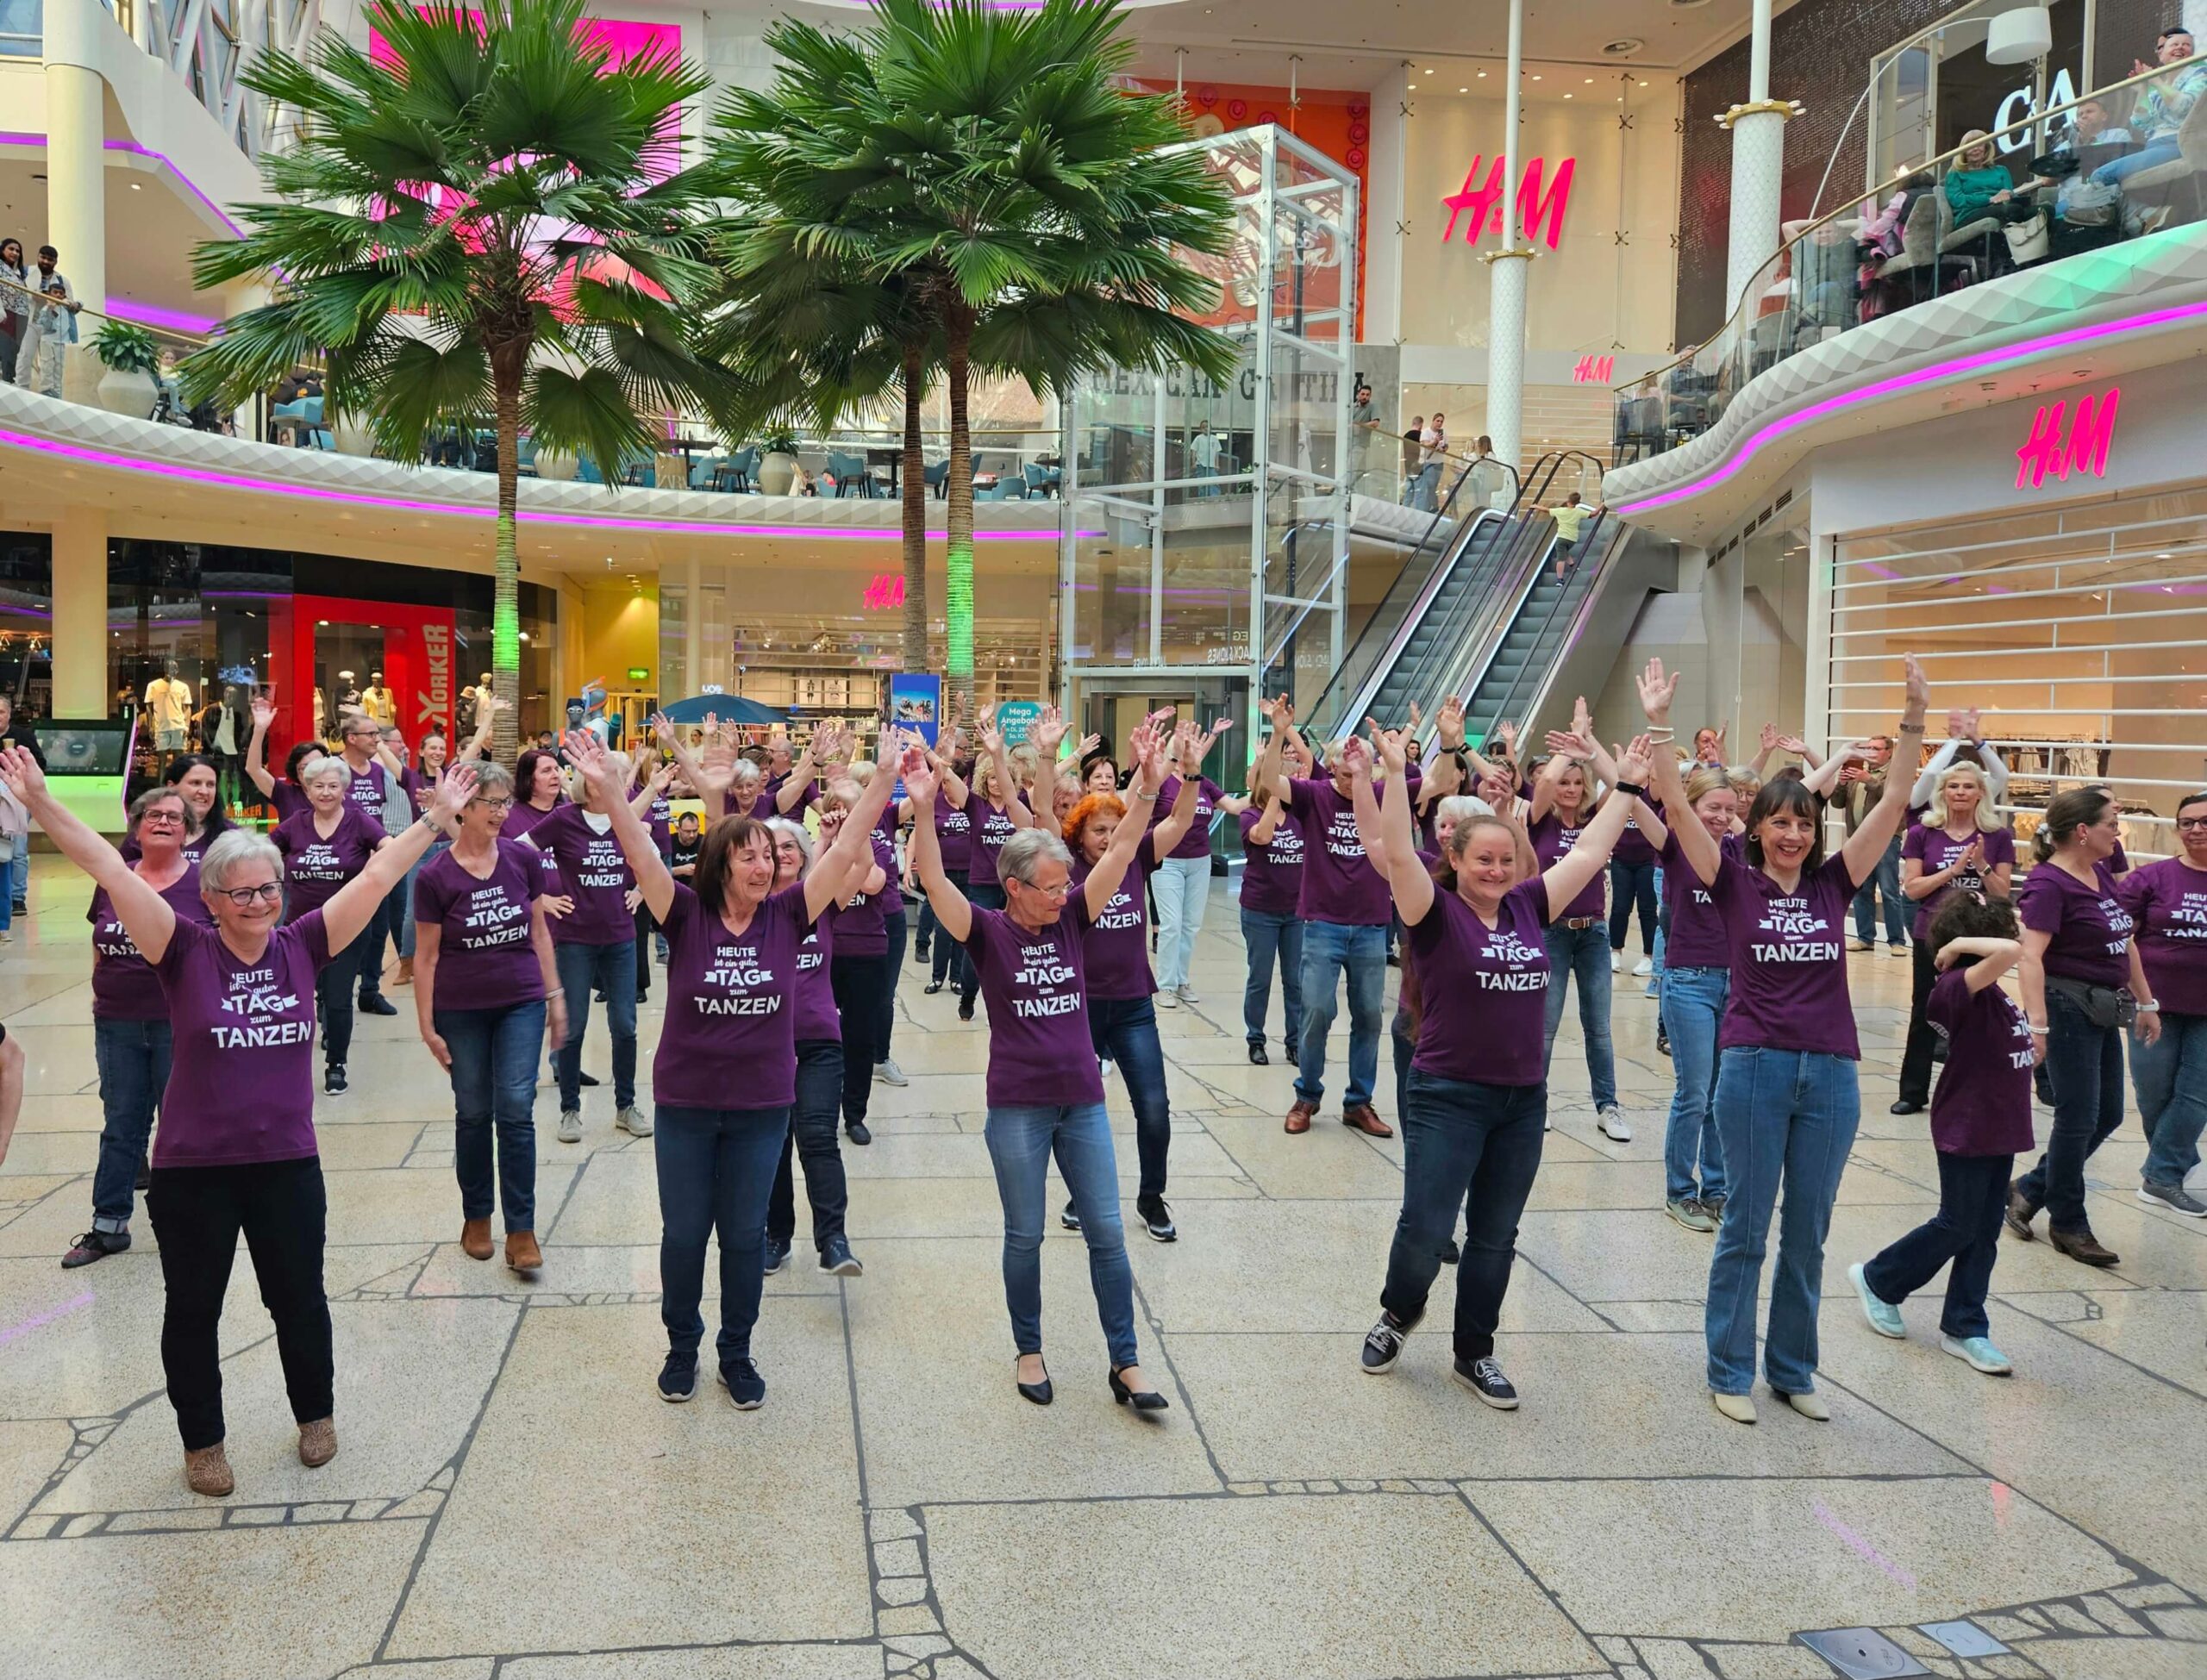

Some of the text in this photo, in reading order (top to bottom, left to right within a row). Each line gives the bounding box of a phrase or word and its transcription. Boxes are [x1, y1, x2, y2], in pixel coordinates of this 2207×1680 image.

[1572, 353, 1615, 384] H&M
[2015, 387, 2121, 490] H&M
[1009, 708, 1032, 717] Mega
[1195, 806, 1212, 815] ZEN
[1325, 840, 1366, 856] TANZE
[305, 854, 332, 865] TAG
[590, 854, 616, 866] TAG
[1267, 852, 1304, 864] TANZE
[578, 873, 624, 887] TANZEN
[472, 885, 505, 902] HEUTE
[1768, 898, 1808, 909] HEUTE
[474, 905, 514, 927] TAG
[1096, 909, 1141, 929] NZEN
[1770, 915, 1816, 934] TAG
[461, 922, 528, 949] TANZEN
[716, 946, 757, 958] HEUTE
[1021, 942, 1056, 957] HEUTE
[1751, 942, 1839, 963] TANZEN
[716, 968, 760, 987] TAG
[1024, 966, 1066, 985] TAG
[1475, 970, 1551, 991] TANZEN
[230, 993, 284, 1015] TAG
[693, 995, 781, 1015] TANZEN
[1011, 992, 1080, 1017] TANZEN
[250, 1015, 273, 1024] zum
[210, 1020, 312, 1049] TANZEN
